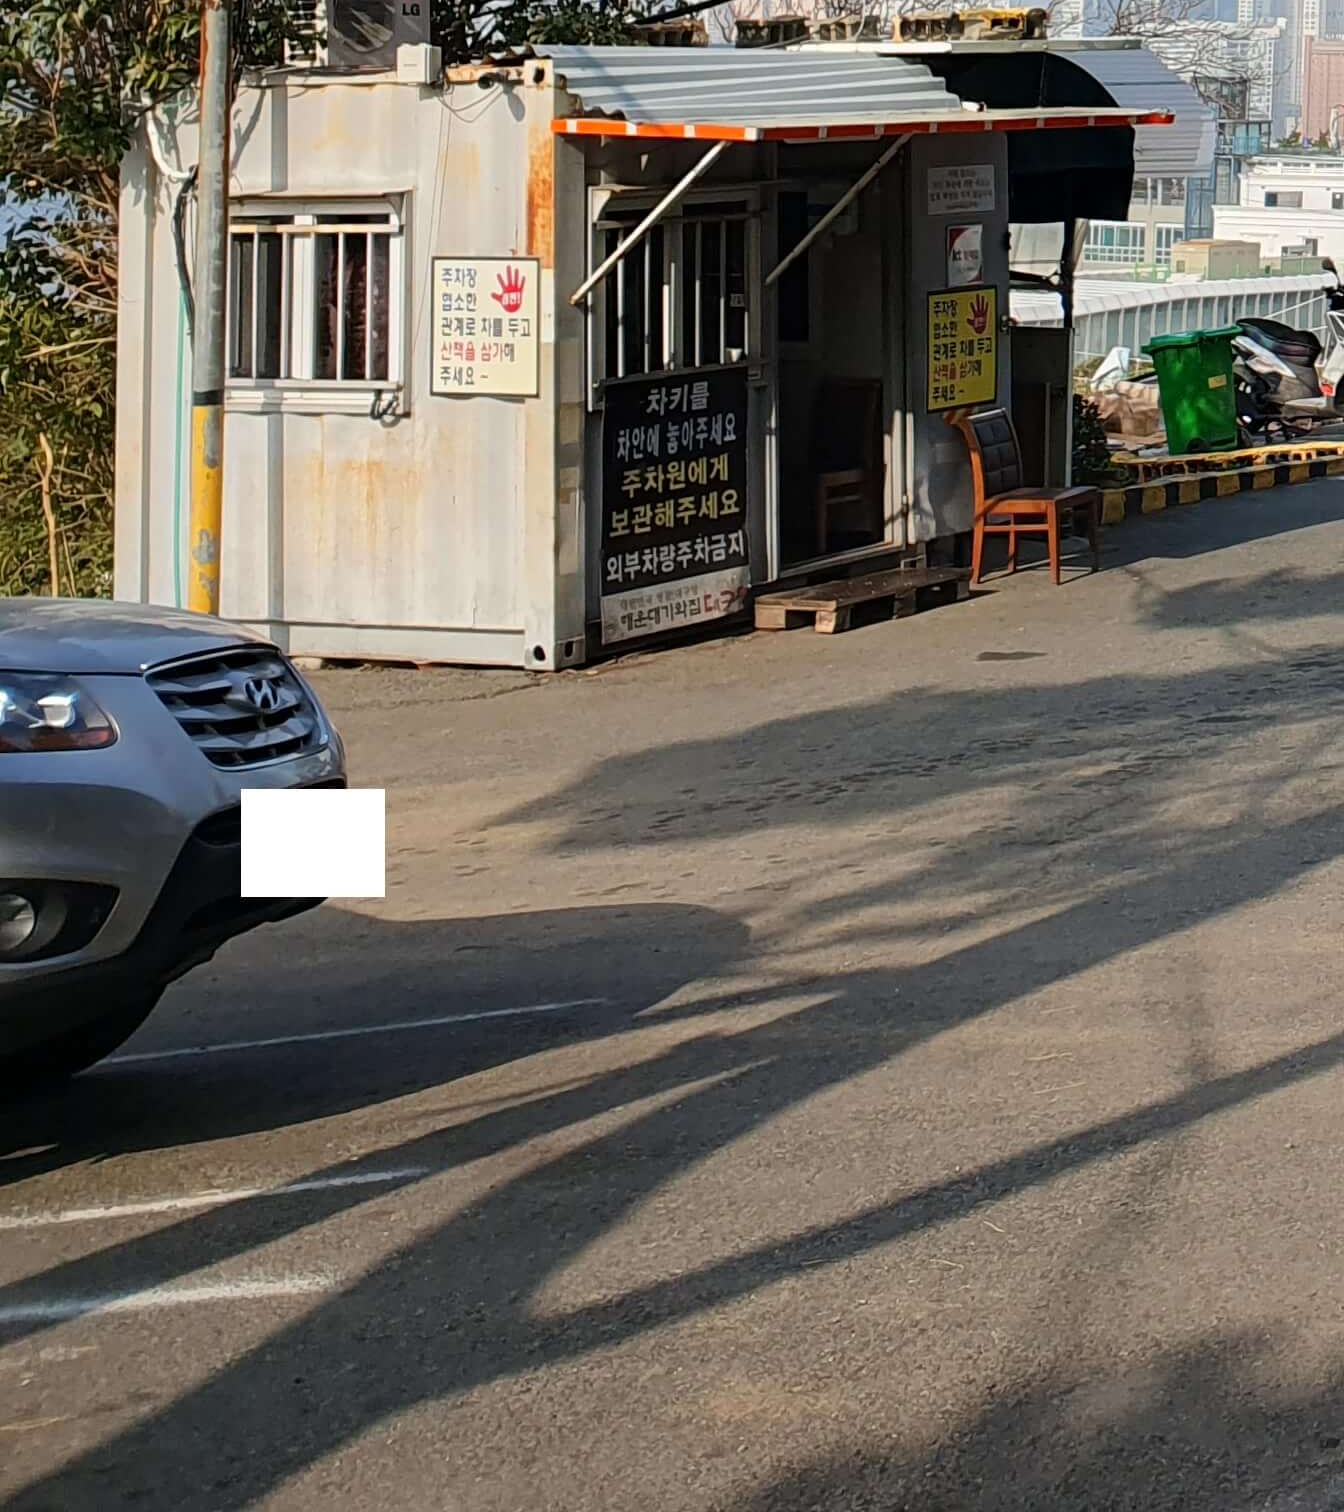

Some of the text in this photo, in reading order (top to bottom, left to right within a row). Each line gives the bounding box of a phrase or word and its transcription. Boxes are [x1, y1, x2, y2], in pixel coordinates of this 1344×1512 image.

[402, 3, 420, 16] LG
[441, 317, 476, 337] 관계로
[508, 318, 531, 337] 두고
[440, 366, 475, 385] 주세요
[645, 381, 710, 416] 차키를
[617, 412, 737, 462] 차안에 놓아주세요
[621, 453, 729, 499] 주차원에게
[609, 489, 740, 537] 보관해주세요
[606, 529, 745, 583] 외부차량주차금지
